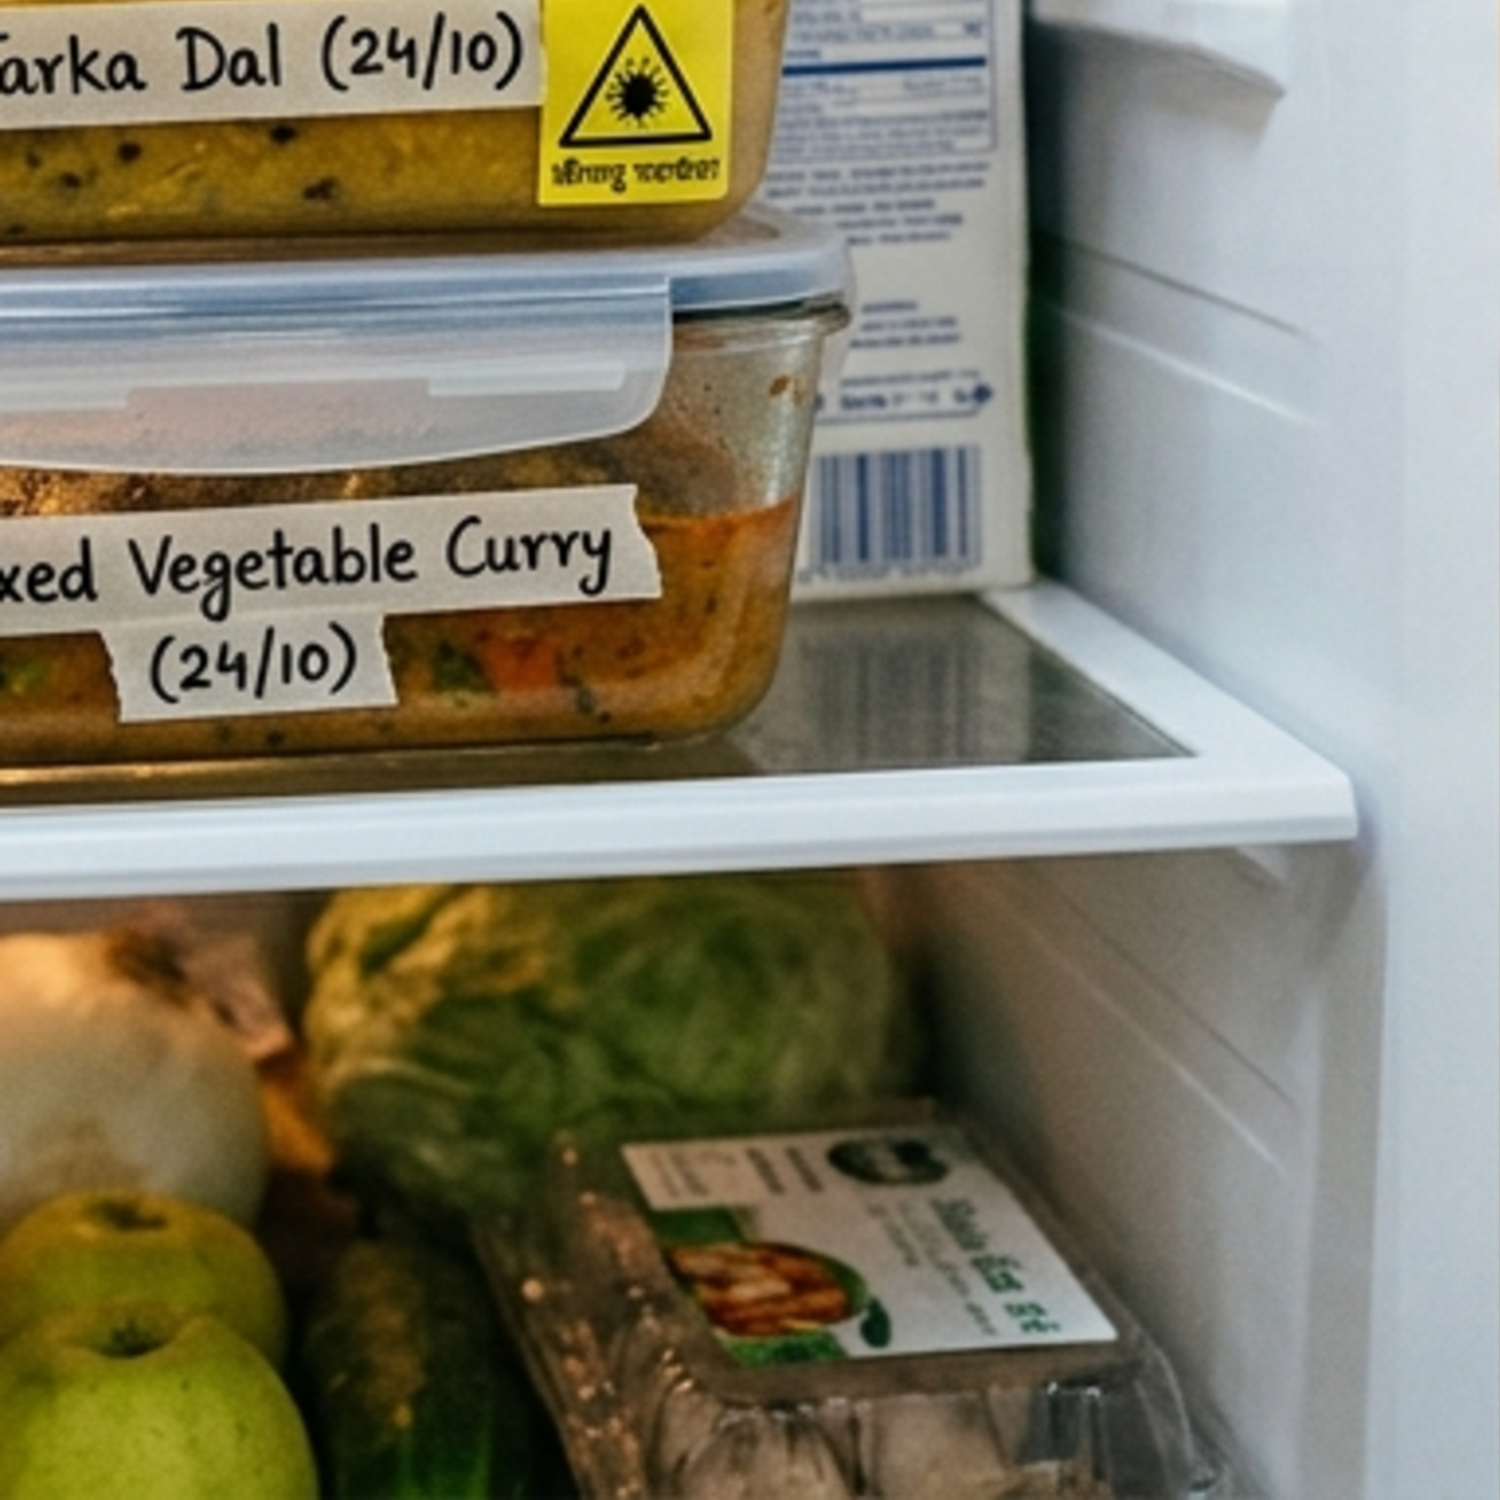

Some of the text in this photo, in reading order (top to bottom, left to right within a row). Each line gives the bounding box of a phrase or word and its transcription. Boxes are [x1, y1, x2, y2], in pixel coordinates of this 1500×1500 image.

[0, 11, 523, 96] arka Dal (24/10)
[128, 522, 418, 621] Vegetable
[446, 514, 612, 597] Curry
[150, 621, 357, 704] (24/10)
